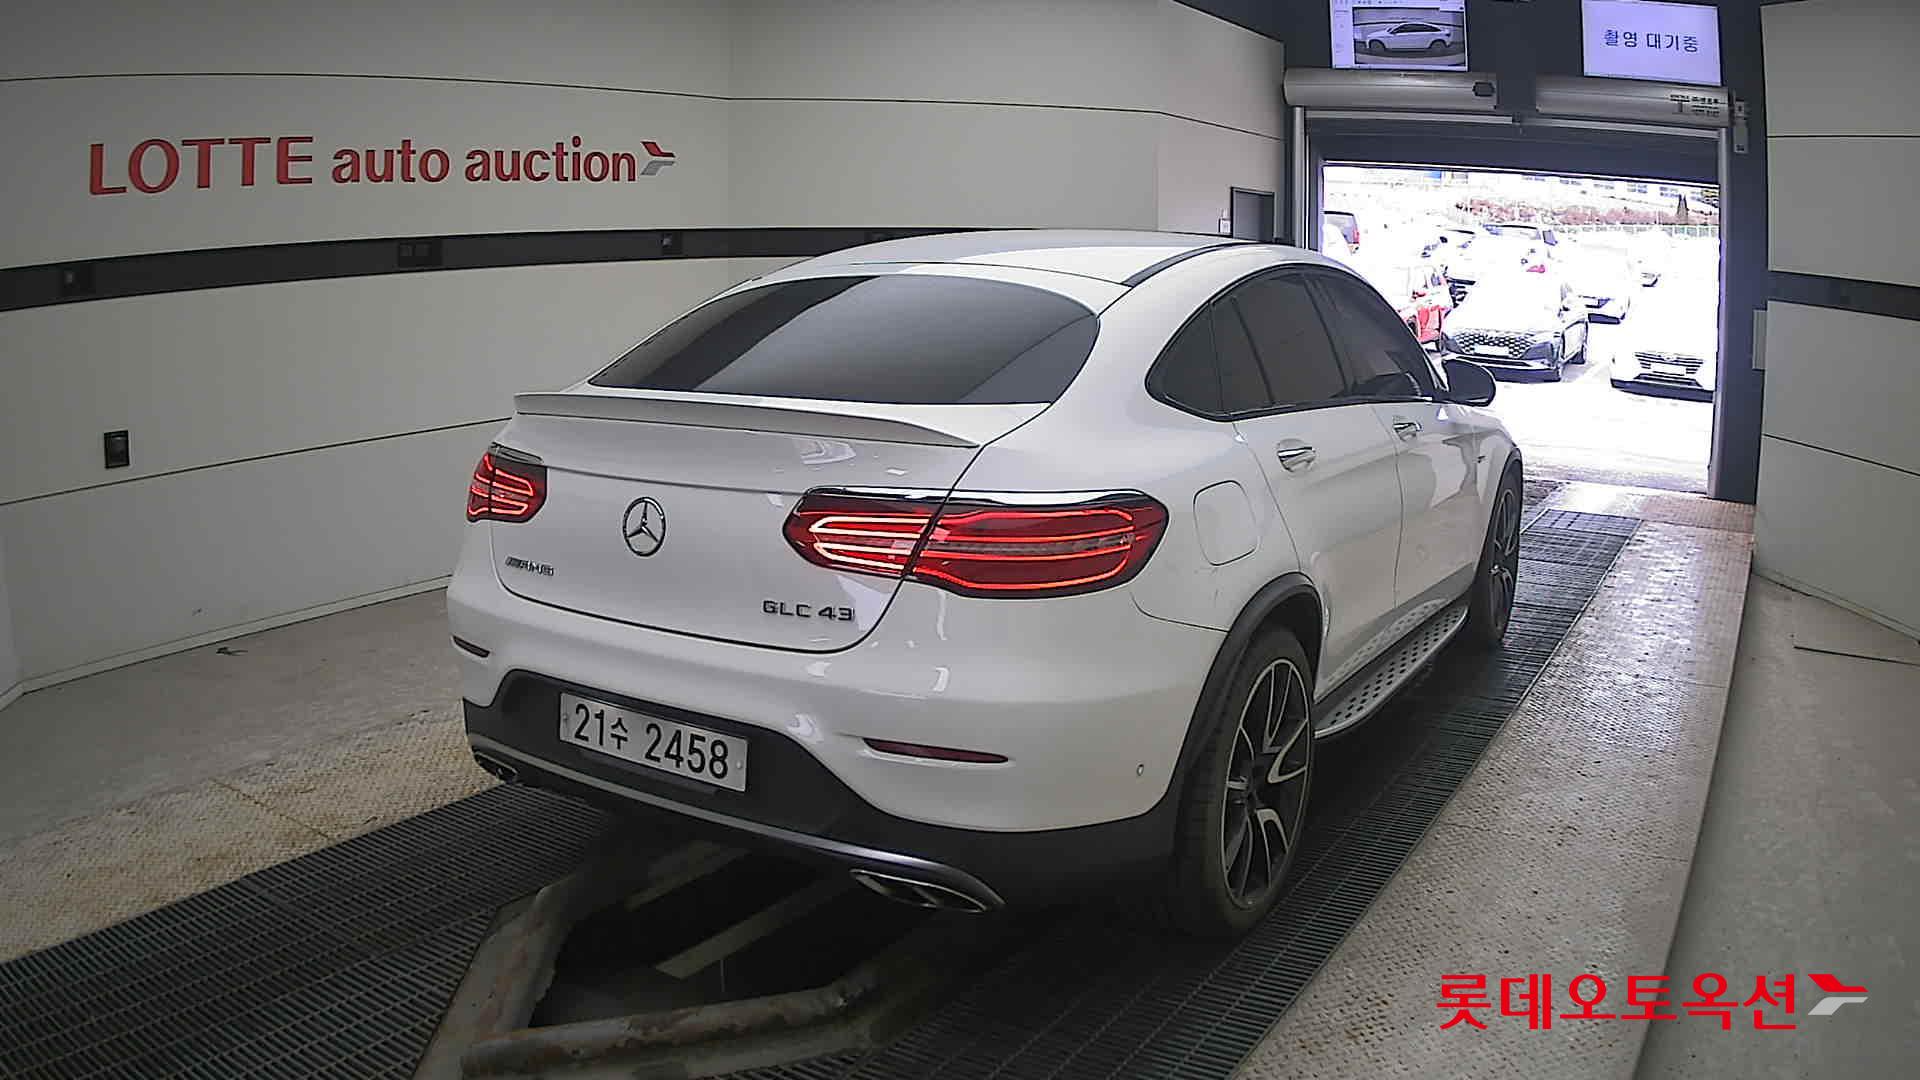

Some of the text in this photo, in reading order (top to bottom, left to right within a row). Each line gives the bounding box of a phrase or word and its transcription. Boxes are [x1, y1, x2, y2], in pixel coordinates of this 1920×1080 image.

[1646, 32, 1698, 52] 대기중
[89, 135, 637, 196] LOTTE auto auction
[763, 600, 855, 621] GLC 43
[574, 703, 728, 779] 21수 2458
